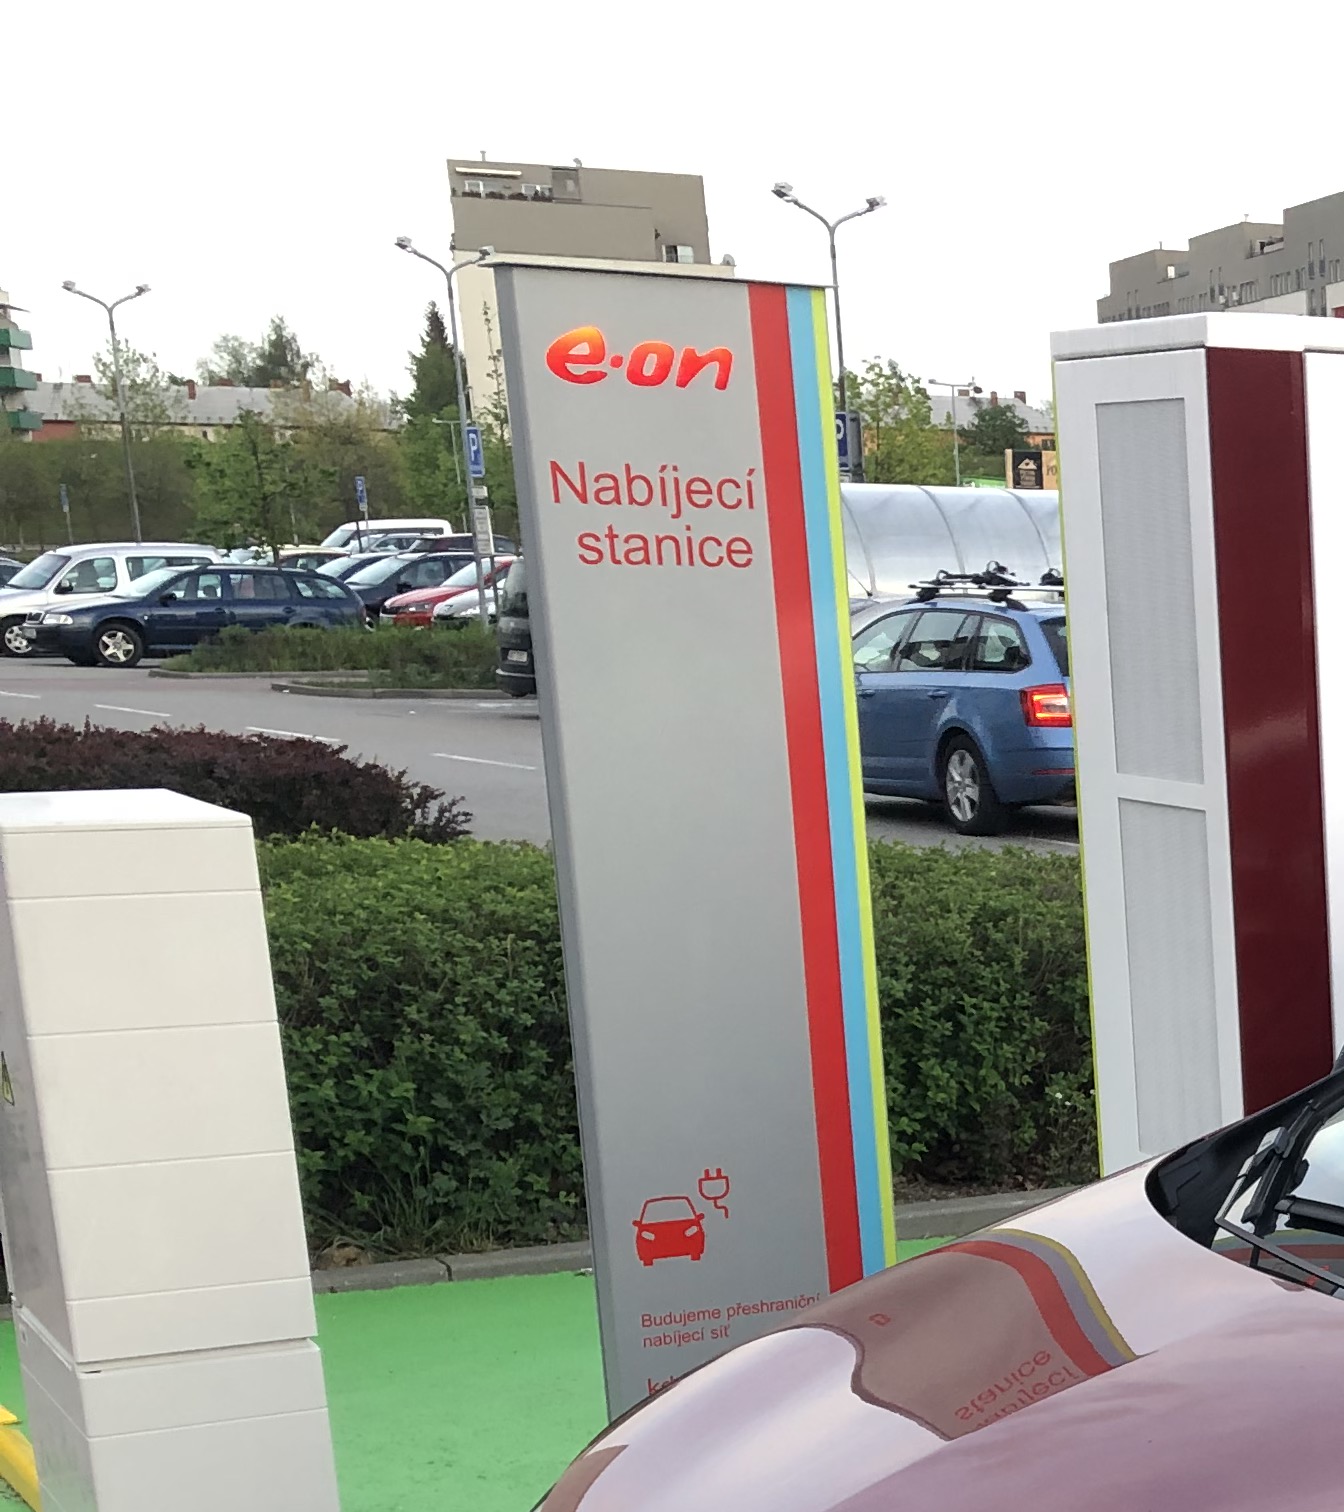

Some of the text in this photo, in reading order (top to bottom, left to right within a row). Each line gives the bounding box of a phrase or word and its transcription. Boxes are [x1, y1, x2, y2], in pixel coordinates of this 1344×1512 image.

[468, 432, 478, 461] P
[549, 460, 756, 519] Nabíjecí
[577, 523, 753, 569] stanice
[641, 1306, 722, 1328] Budujeme
[643, 1326, 705, 1348] nabíjecí
